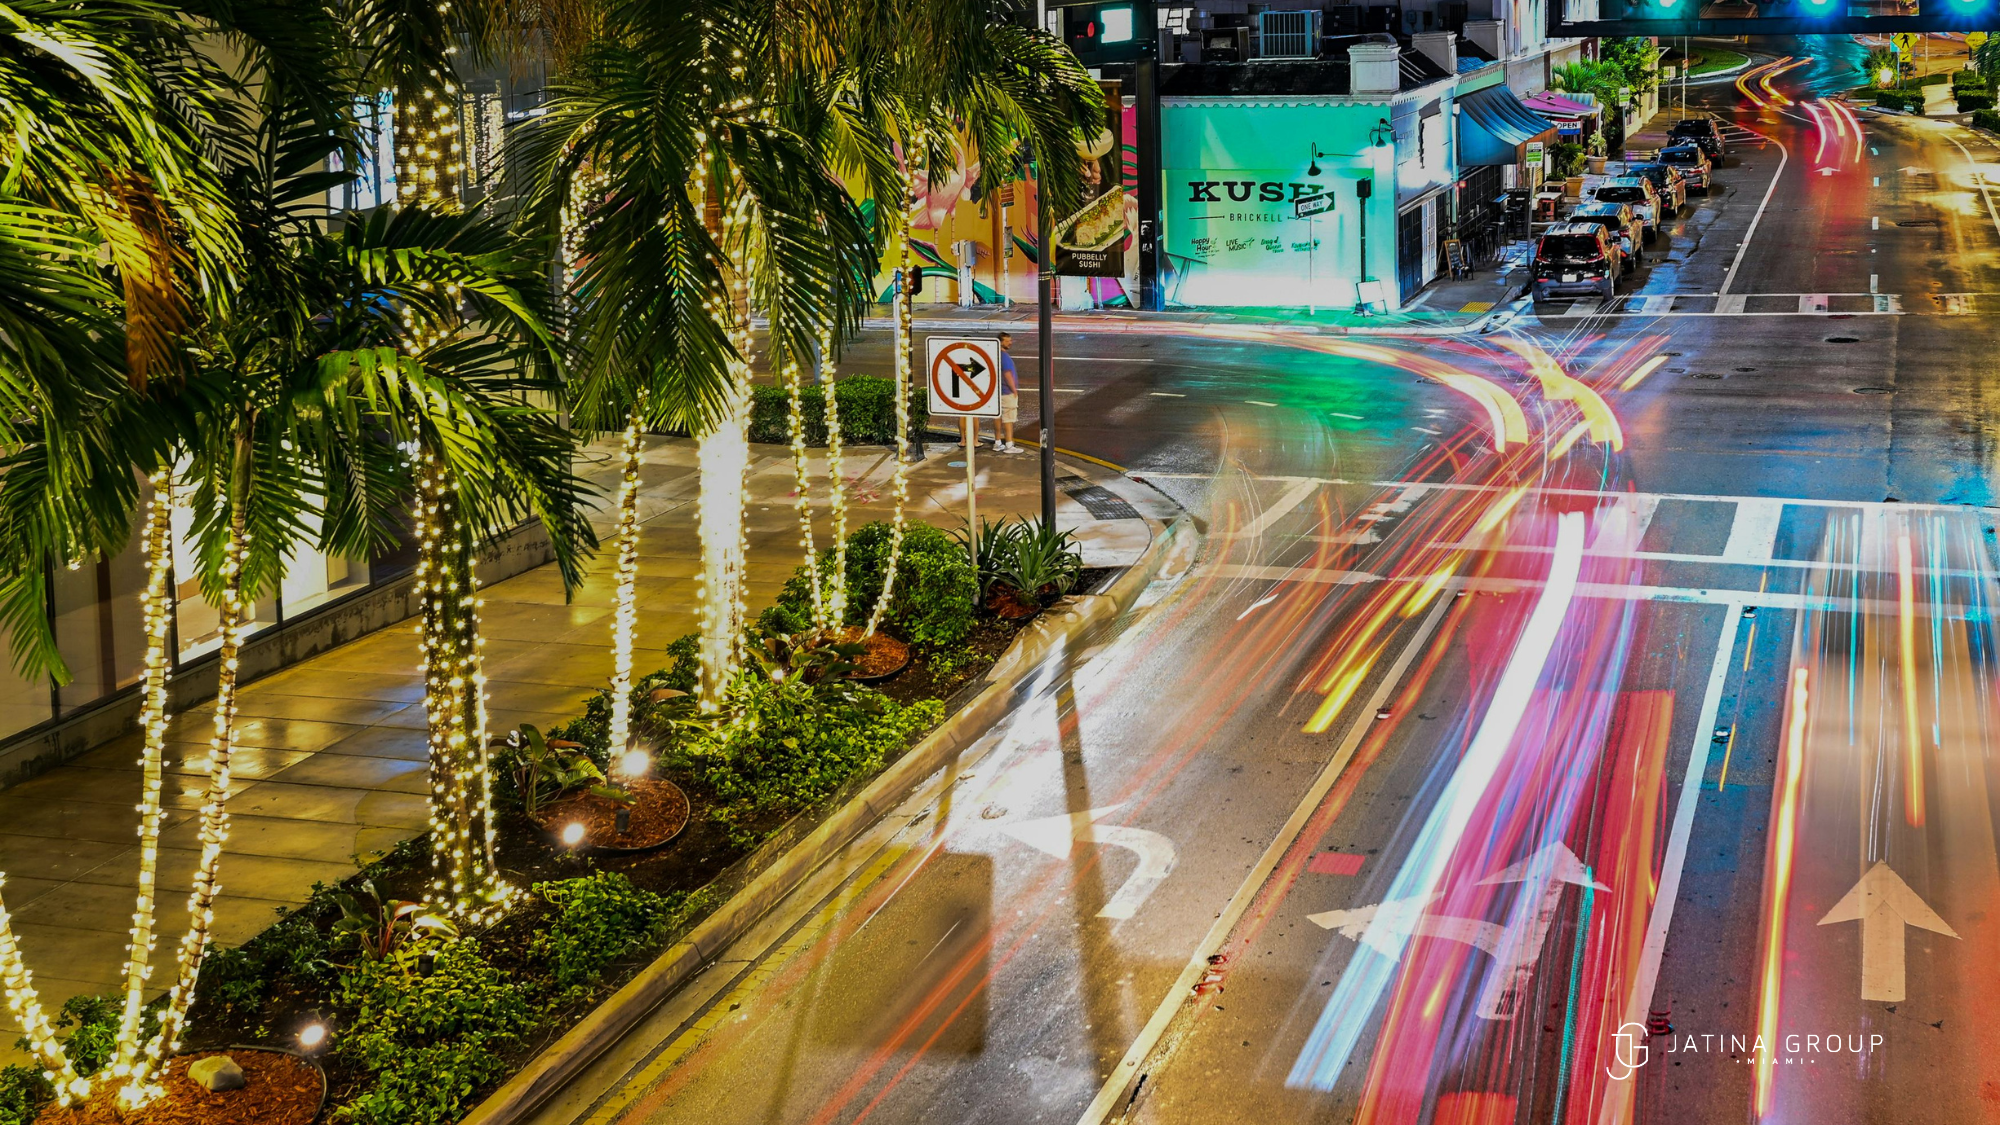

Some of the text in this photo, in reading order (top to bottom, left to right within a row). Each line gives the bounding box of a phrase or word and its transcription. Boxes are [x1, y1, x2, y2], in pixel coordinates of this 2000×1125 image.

[1556, 121, 1578, 129] OPEN
[1188, 181, 1324, 202] KUSH
[1300, 200, 1323, 211] ONE WAY
[1229, 213, 1283, 222] BRICKELL
[1226, 238, 1239, 246] LIVE
[1228, 243, 1247, 252] MUSIC
[1071, 252, 1108, 261] PUBBELLY
